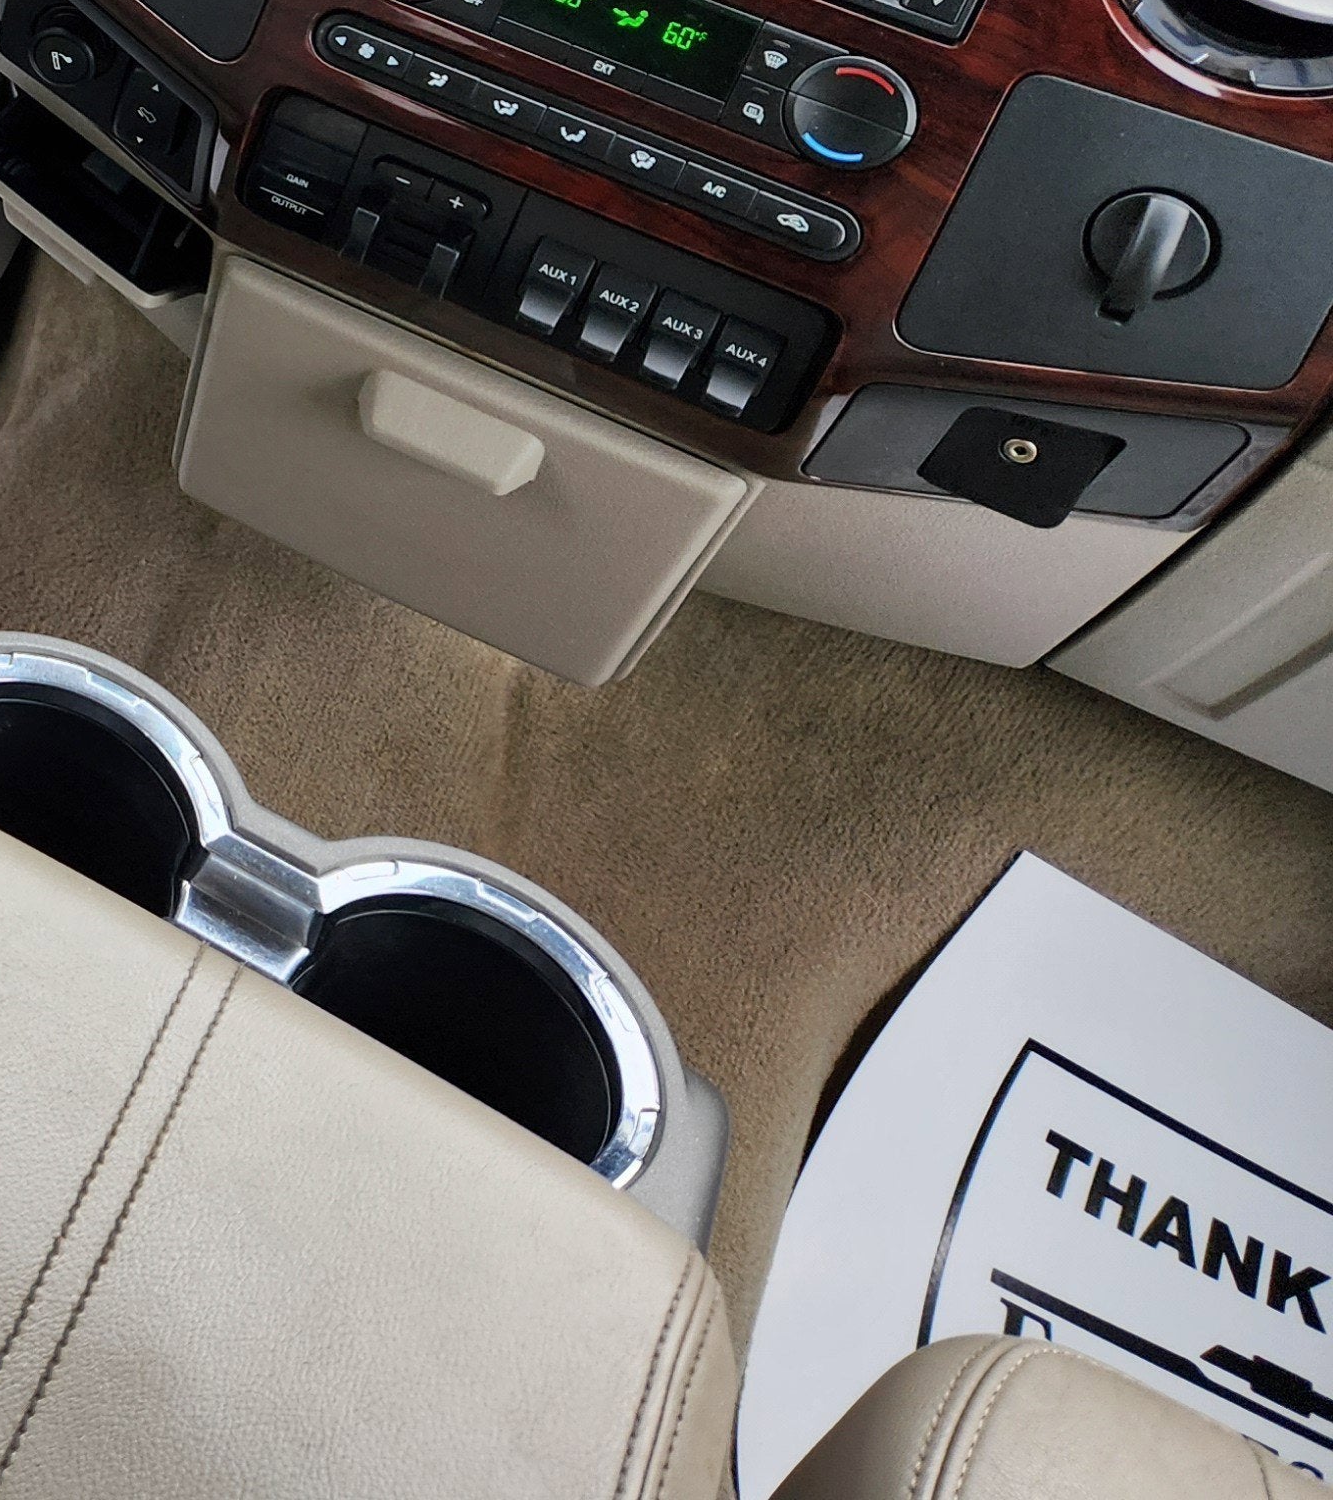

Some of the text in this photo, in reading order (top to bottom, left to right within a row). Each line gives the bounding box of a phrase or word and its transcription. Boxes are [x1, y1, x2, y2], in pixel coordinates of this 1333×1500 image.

[593, 60, 616, 75] EXT
[285, 173, 309, 188] GAIN
[702, 181, 726, 198] A/C
[271, 195, 307, 216] OUTPUT
[538, 262, 577, 286] AUX 1
[598, 288, 640, 314] AUX 2
[661, 316, 704, 340] AUX 3
[725, 342, 768, 368] AUX 4
[1045, 1129, 1331, 1335] THANK
